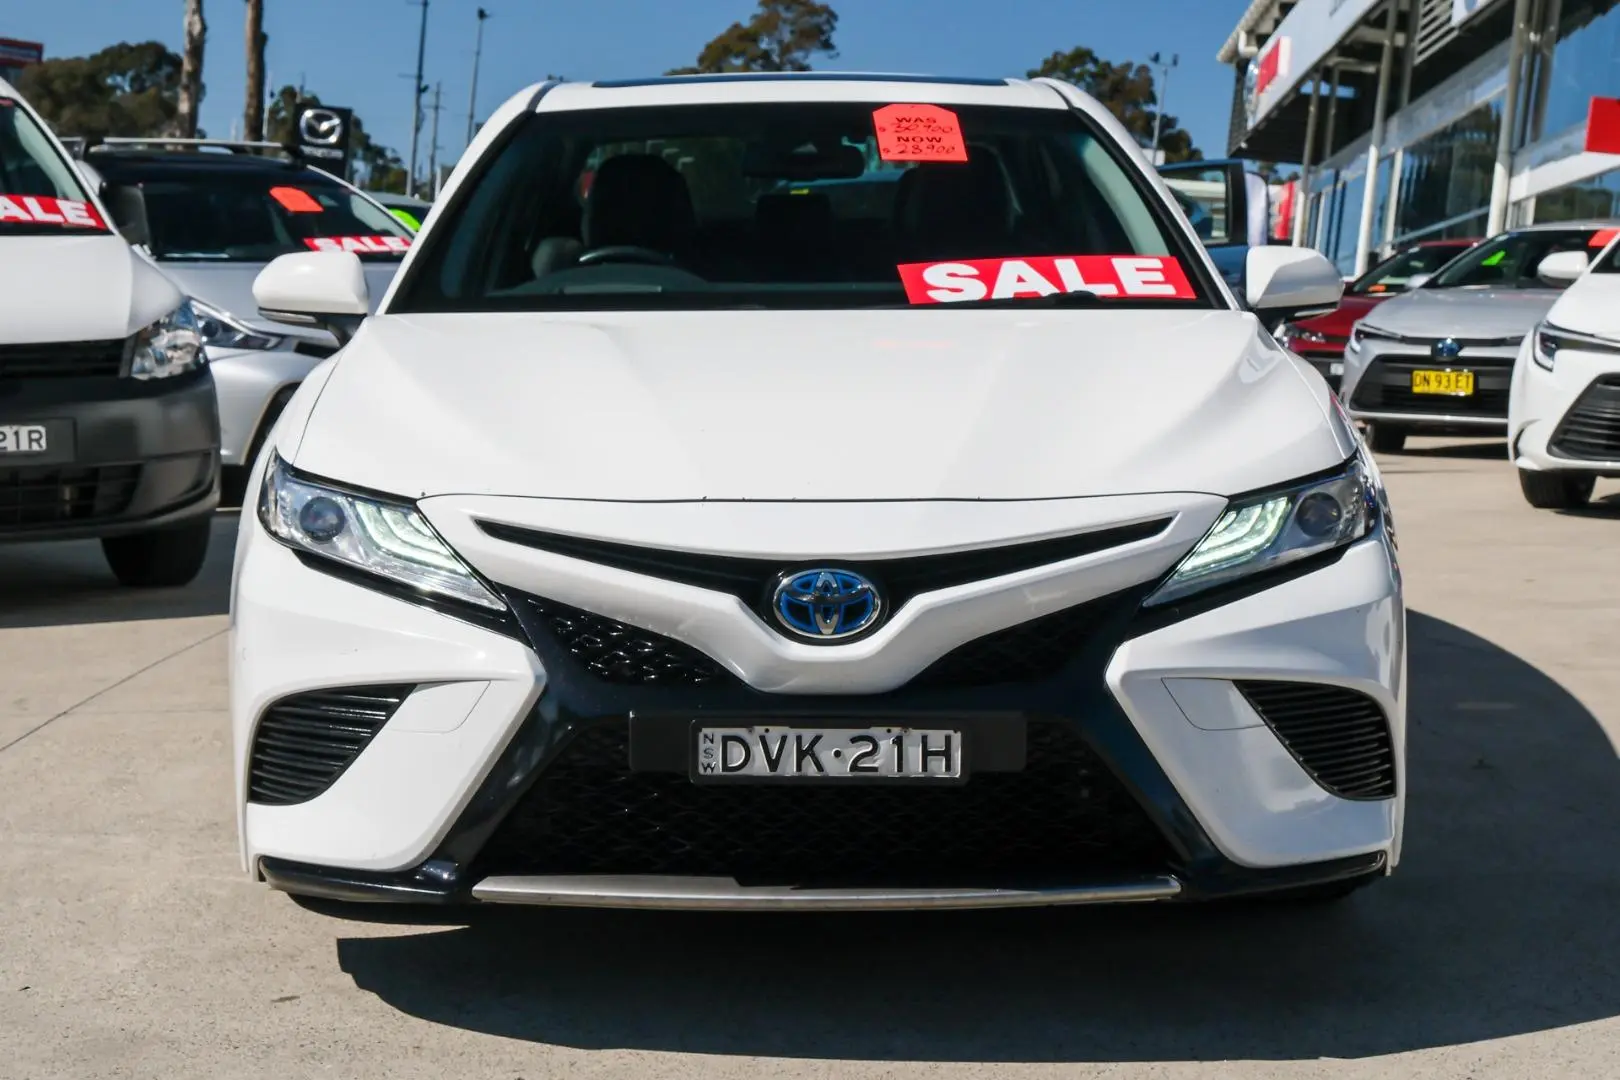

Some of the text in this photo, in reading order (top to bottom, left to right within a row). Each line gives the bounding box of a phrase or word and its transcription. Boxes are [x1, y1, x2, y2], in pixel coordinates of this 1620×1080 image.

[313, 236, 411, 252] SALE
[922, 257, 1177, 302] SALE
[702, 733, 716, 773] NSW
